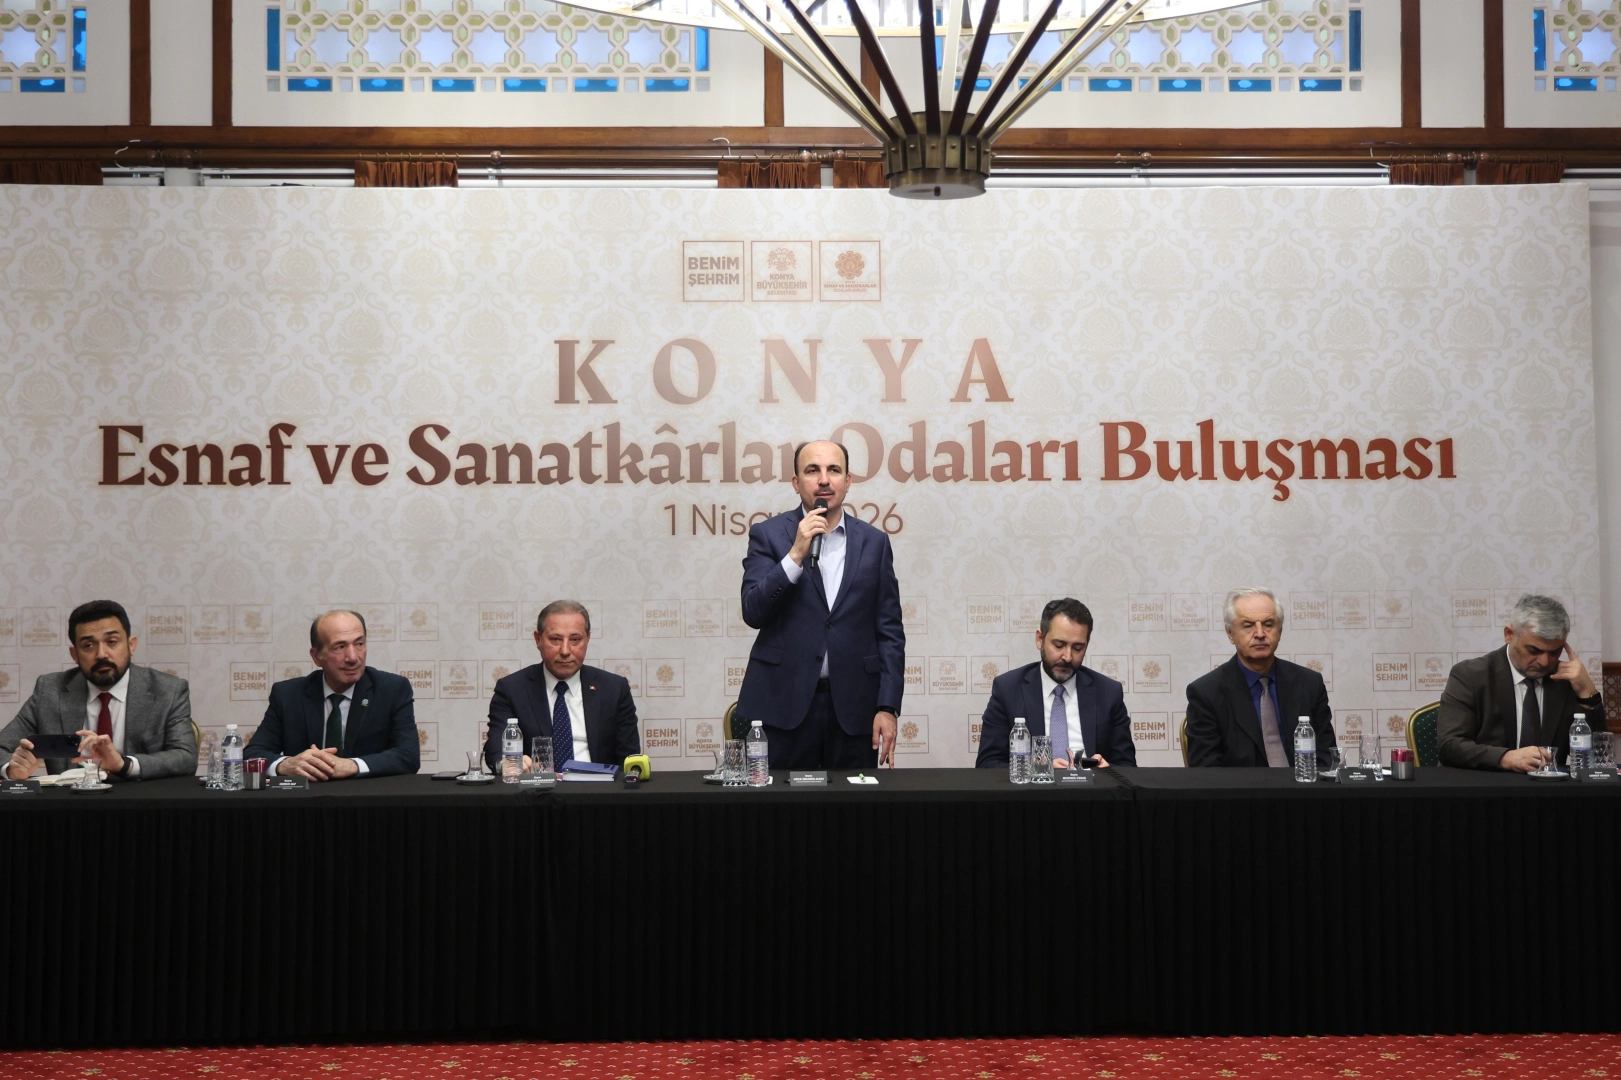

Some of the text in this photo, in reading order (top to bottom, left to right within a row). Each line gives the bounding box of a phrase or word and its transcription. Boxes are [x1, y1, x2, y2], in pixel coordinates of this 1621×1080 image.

[554, 337, 1015, 405] KONYA
[98, 418, 1457, 501] Esnaf ve Sanatkârlar Odaları Buluşması
[663, 503, 676, 536] 1
